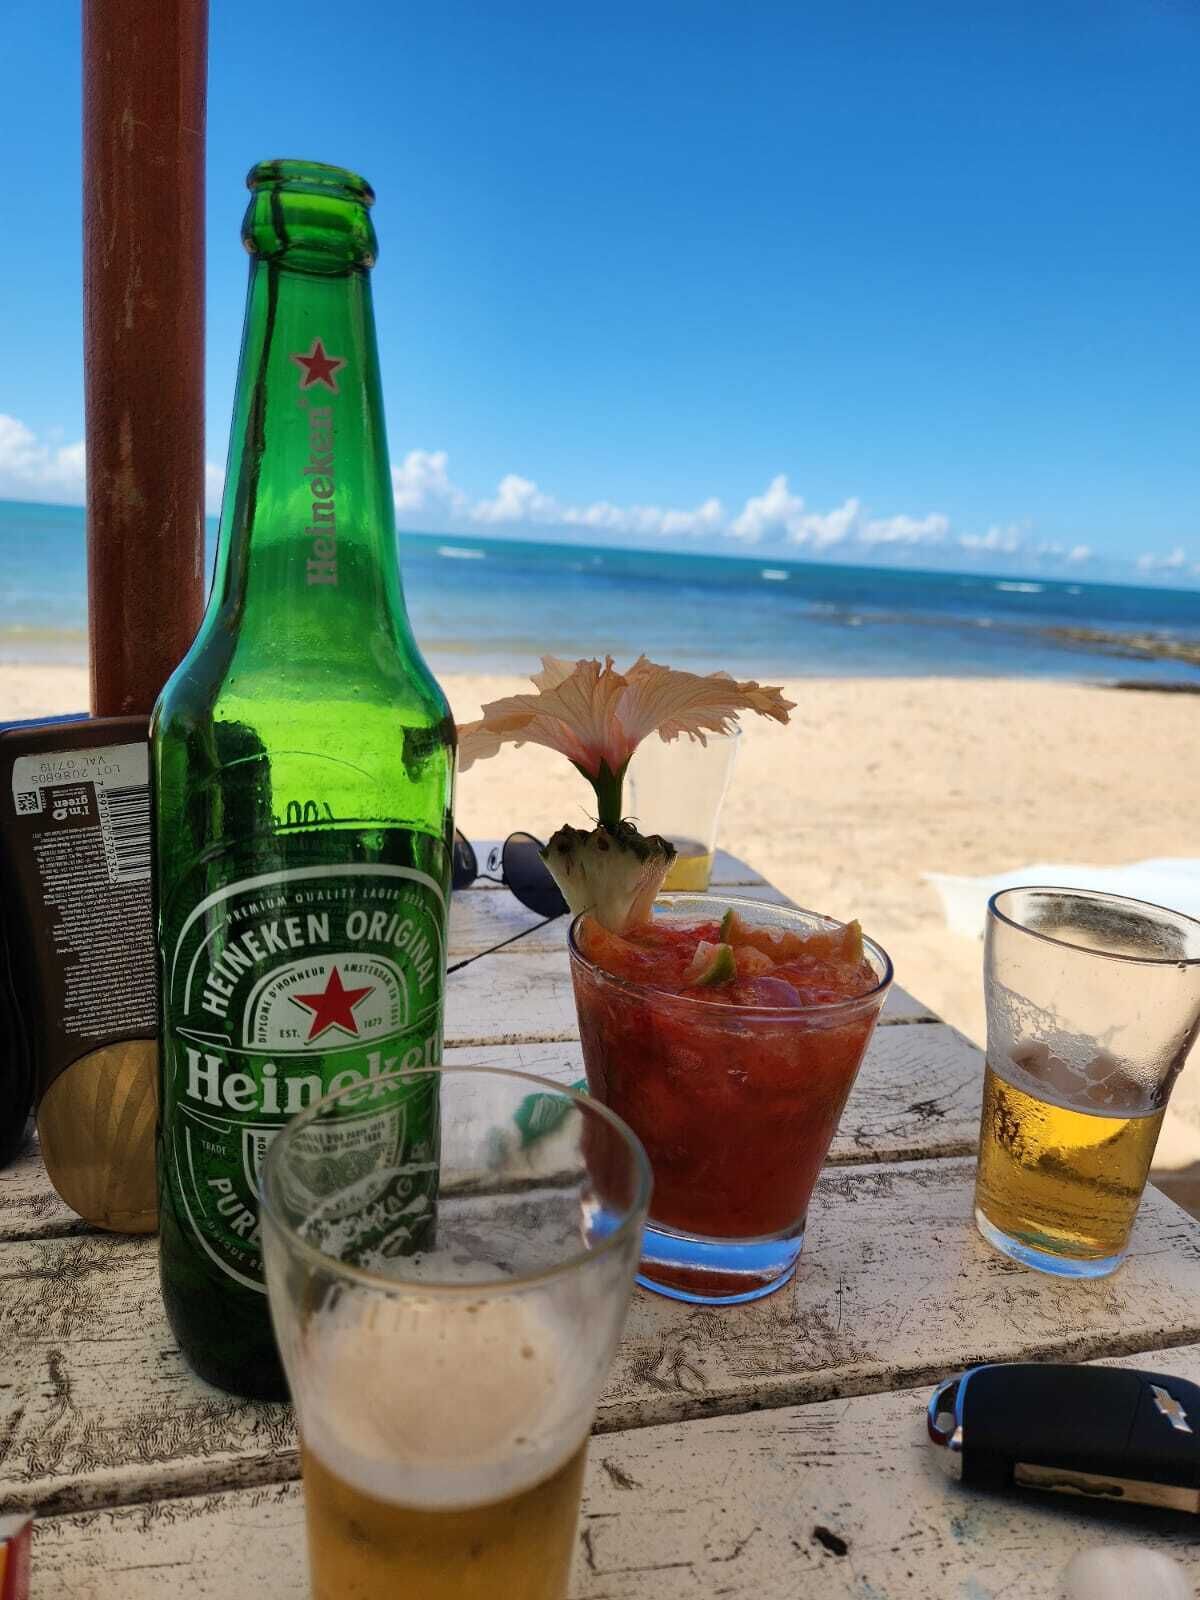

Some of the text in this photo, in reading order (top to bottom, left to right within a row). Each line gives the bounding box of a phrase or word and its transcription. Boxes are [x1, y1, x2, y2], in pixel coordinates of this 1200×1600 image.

[303, 407, 337, 586] Heineken
[53, 795, 89, 808] green
[225, 895, 287, 925] PREMIUM
[295, 887, 356, 904] QUALITY
[362, 887, 400, 900] LAGER
[201, 912, 331, 1018] HEINEKEN
[345, 909, 435, 995] ORIGINAL
[257, 1000, 273, 1044] DIPLOME
[270, 966, 325, 1000] D'HONNEUR
[343, 963, 393, 987] AMSTERDAM
[279, 1028, 301, 1039] EST.
[201, 1139, 228, 1156] TRADE
